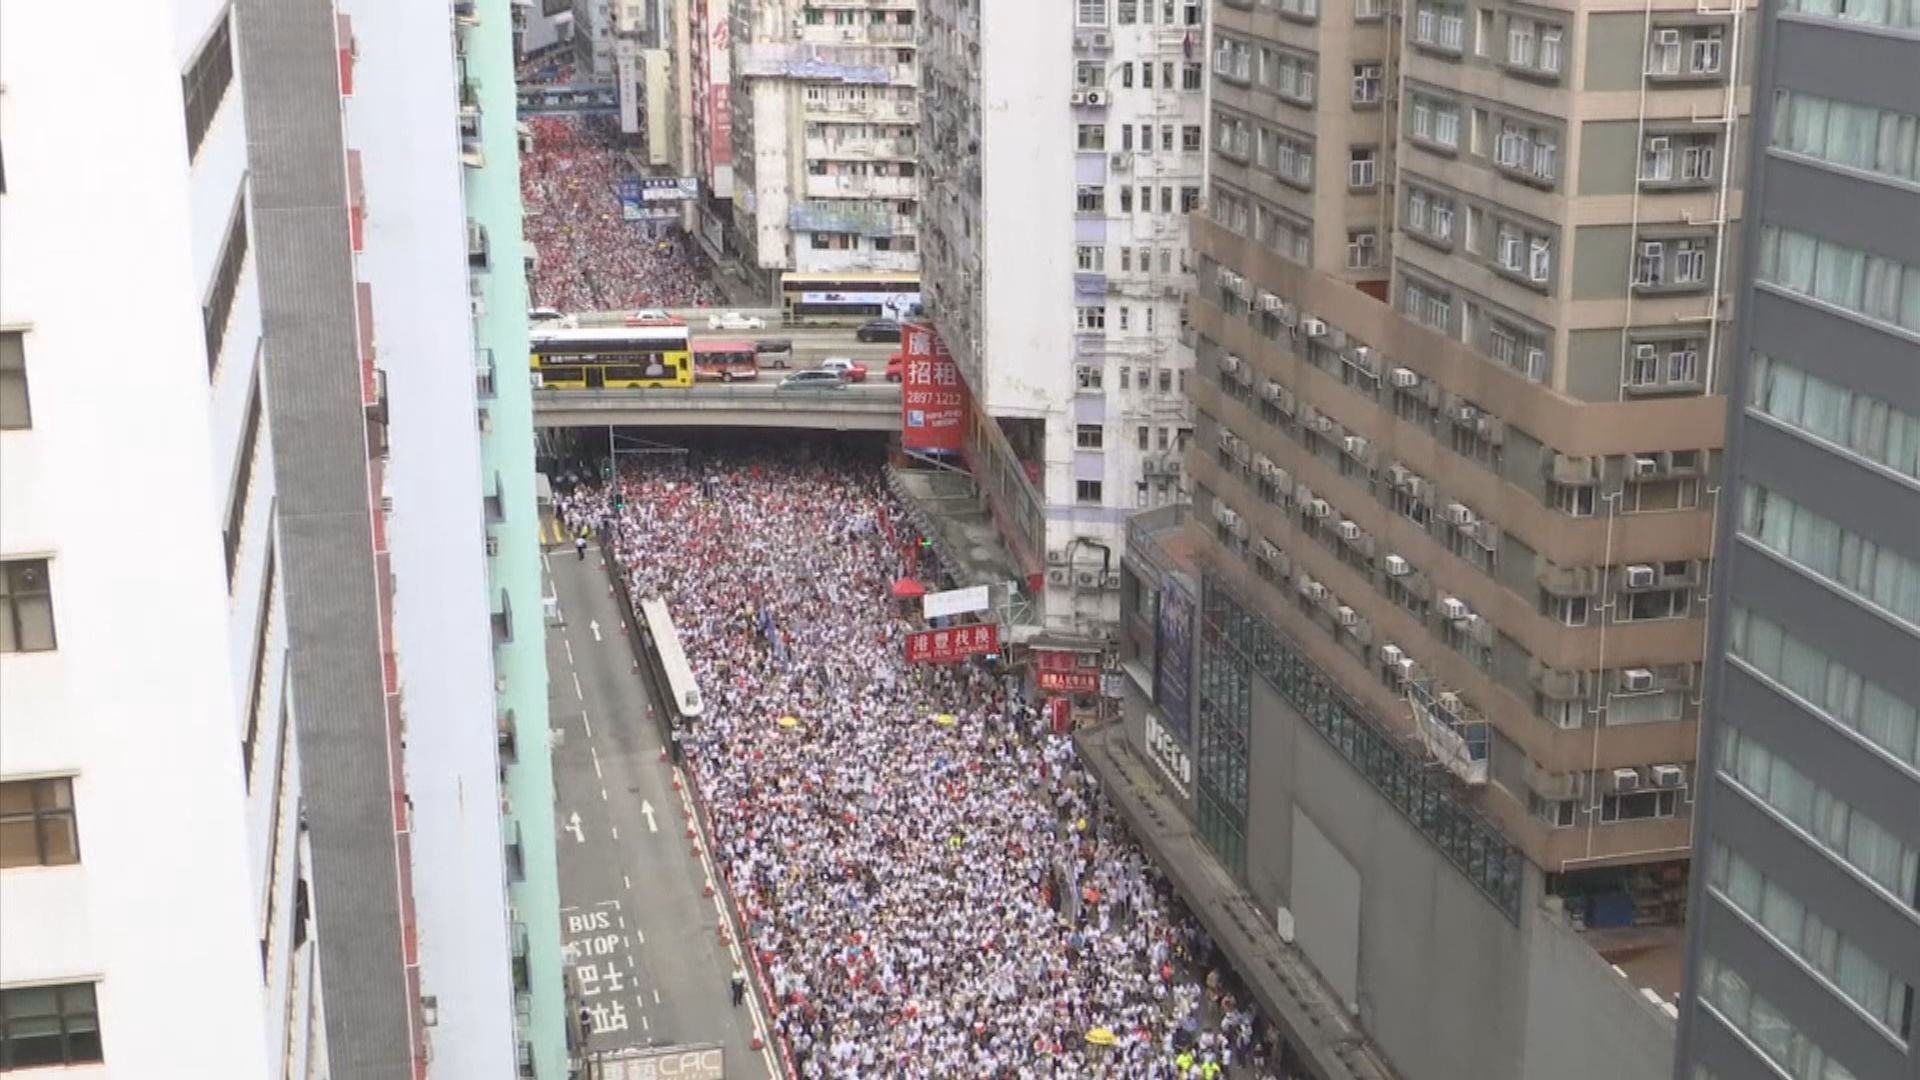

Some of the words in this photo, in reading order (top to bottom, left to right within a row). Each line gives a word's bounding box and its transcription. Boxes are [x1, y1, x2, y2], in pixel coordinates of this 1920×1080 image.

[908, 360, 957, 384] 招租
[907, 391, 932, 403] 2897
[935, 391, 960, 405] 1212
[569, 912, 610, 933] BUS
[568, 935, 619, 957] STOP
[576, 962, 624, 995] 巴士
[591, 1000, 628, 1034] 站
[660, 1050, 721, 1075] CAC
